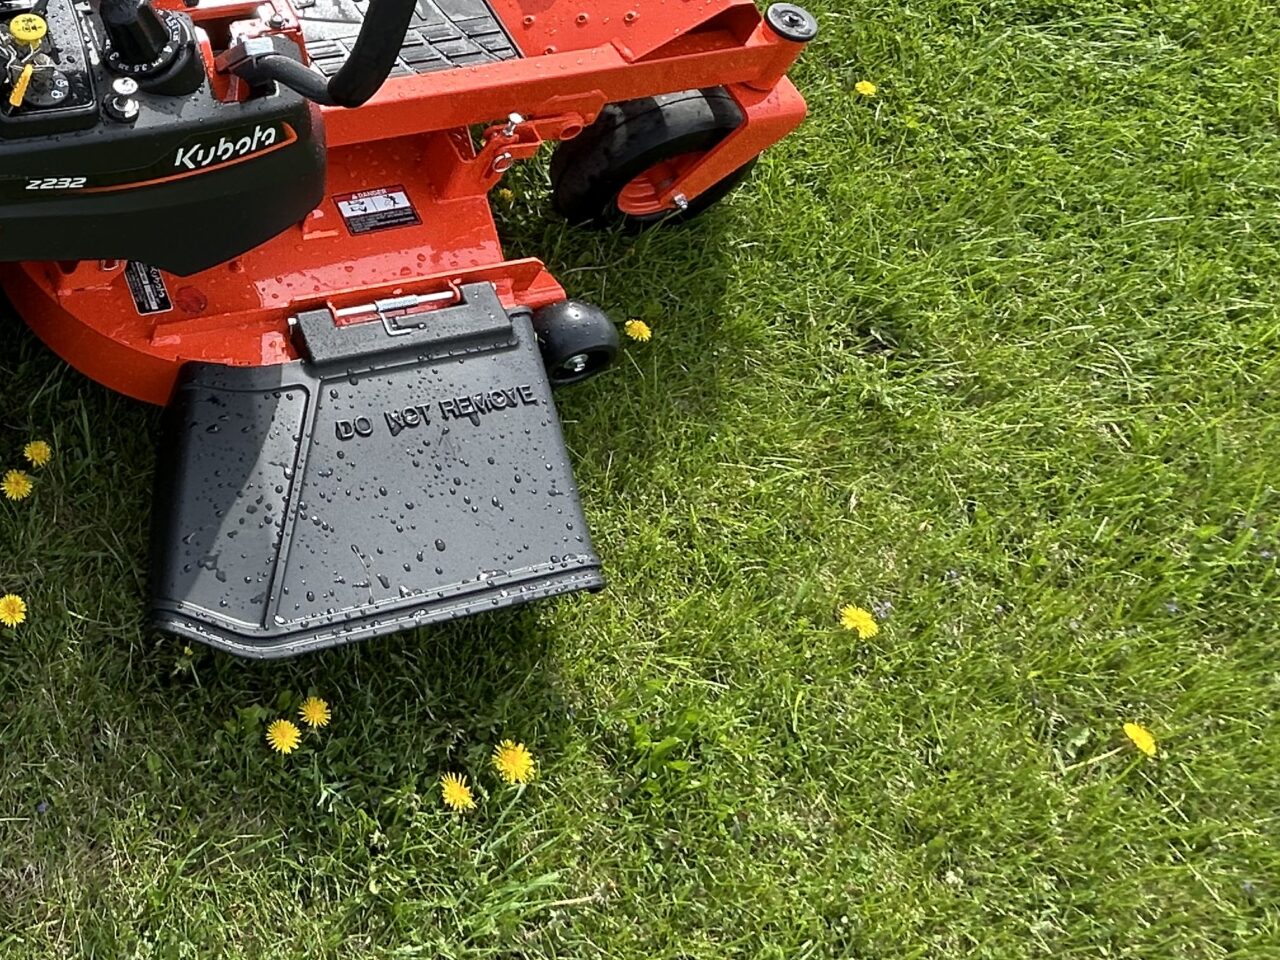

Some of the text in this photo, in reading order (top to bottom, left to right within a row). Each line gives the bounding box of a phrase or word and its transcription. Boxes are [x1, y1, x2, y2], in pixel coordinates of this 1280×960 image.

[174, 125, 276, 169] Kubota
[335, 385, 539, 440] DO NOT REMOVE
